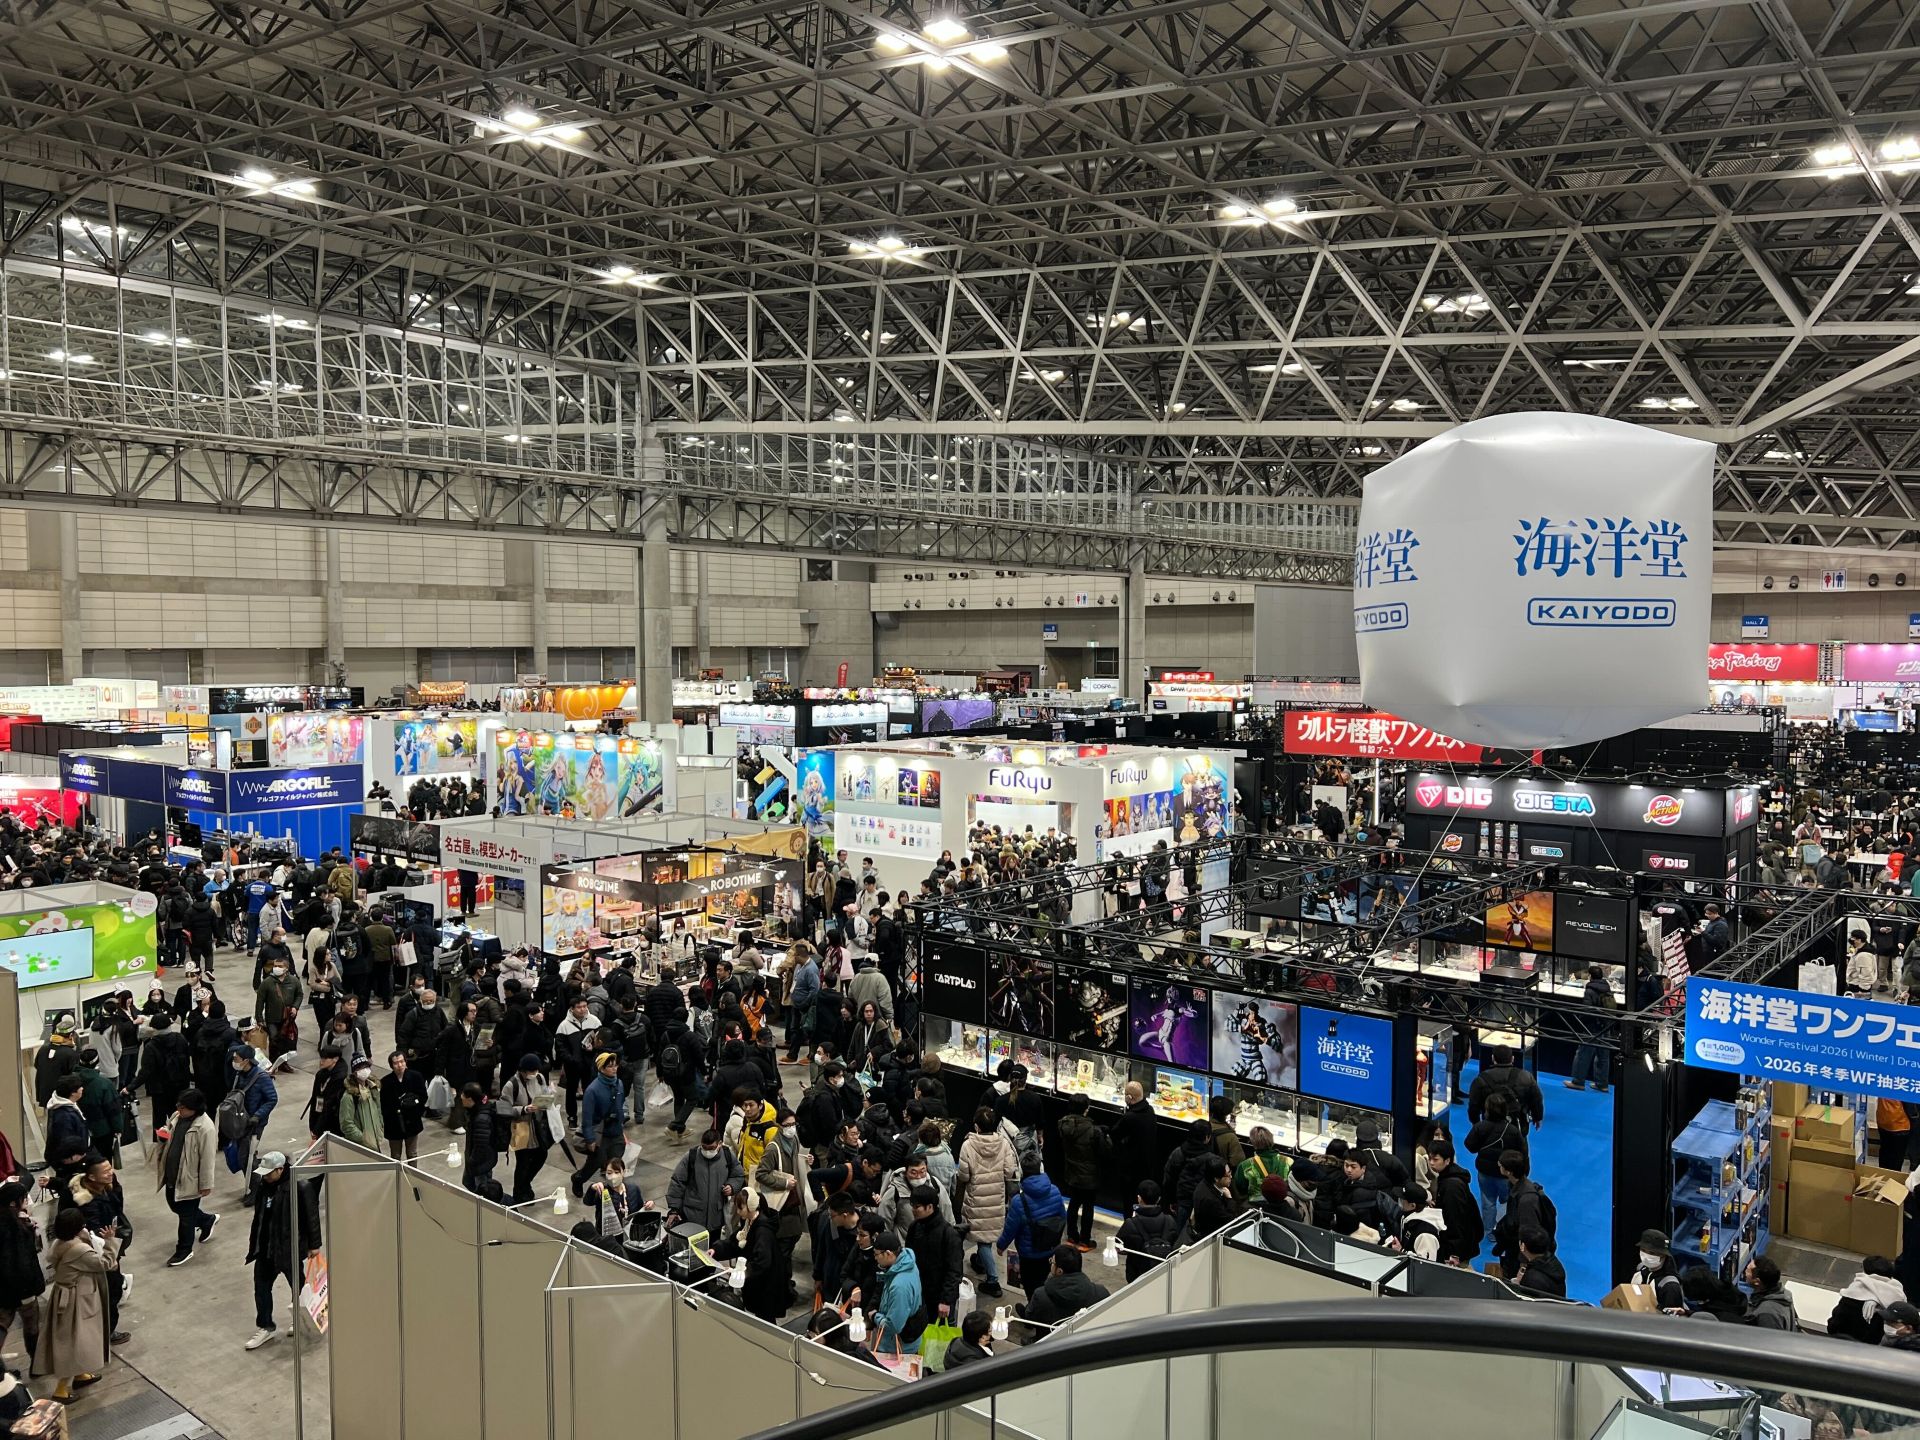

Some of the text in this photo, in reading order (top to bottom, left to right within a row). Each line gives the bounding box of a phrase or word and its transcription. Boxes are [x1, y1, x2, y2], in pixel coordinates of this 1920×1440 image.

[1513, 516, 1689, 579] 海洋堂
[1355, 528, 1420, 588] 洋堂
[1537, 604, 1669, 621] KAIYODO
[1724, 651, 1781, 672] Factory
[244, 686, 300, 700] 52TOYS
[180, 777, 211, 794] ARGOFILE
[266, 776, 332, 794] ARGOFILE
[256, 790, 339, 803] アルゴファイルジャパン株式会社
[1446, 786, 1493, 807] DIG
[1515, 793, 1594, 814] DIGSTA
[1655, 799, 1673, 809] DIG
[1649, 805, 1681, 817] ACTION
[1664, 858, 1689, 869] DIG
[577, 876, 619, 894] ROBOTIME
[710, 872, 762, 891] ROBOTIME
[1565, 920, 1617, 932] REVOLTECH
[1700, 987, 1920, 1050] 海洋堂ワンフェ
[1317, 1036, 1374, 1065] 海洋堂
[1740, 1033, 1776, 1046] Wonder
[1778, 1036, 1818, 1053] Festival
[1821, 1045, 1848, 1057] 2026
[1856, 1050, 1889, 1064] Winter
[1323, 1063, 1367, 1077] KAIYODO
